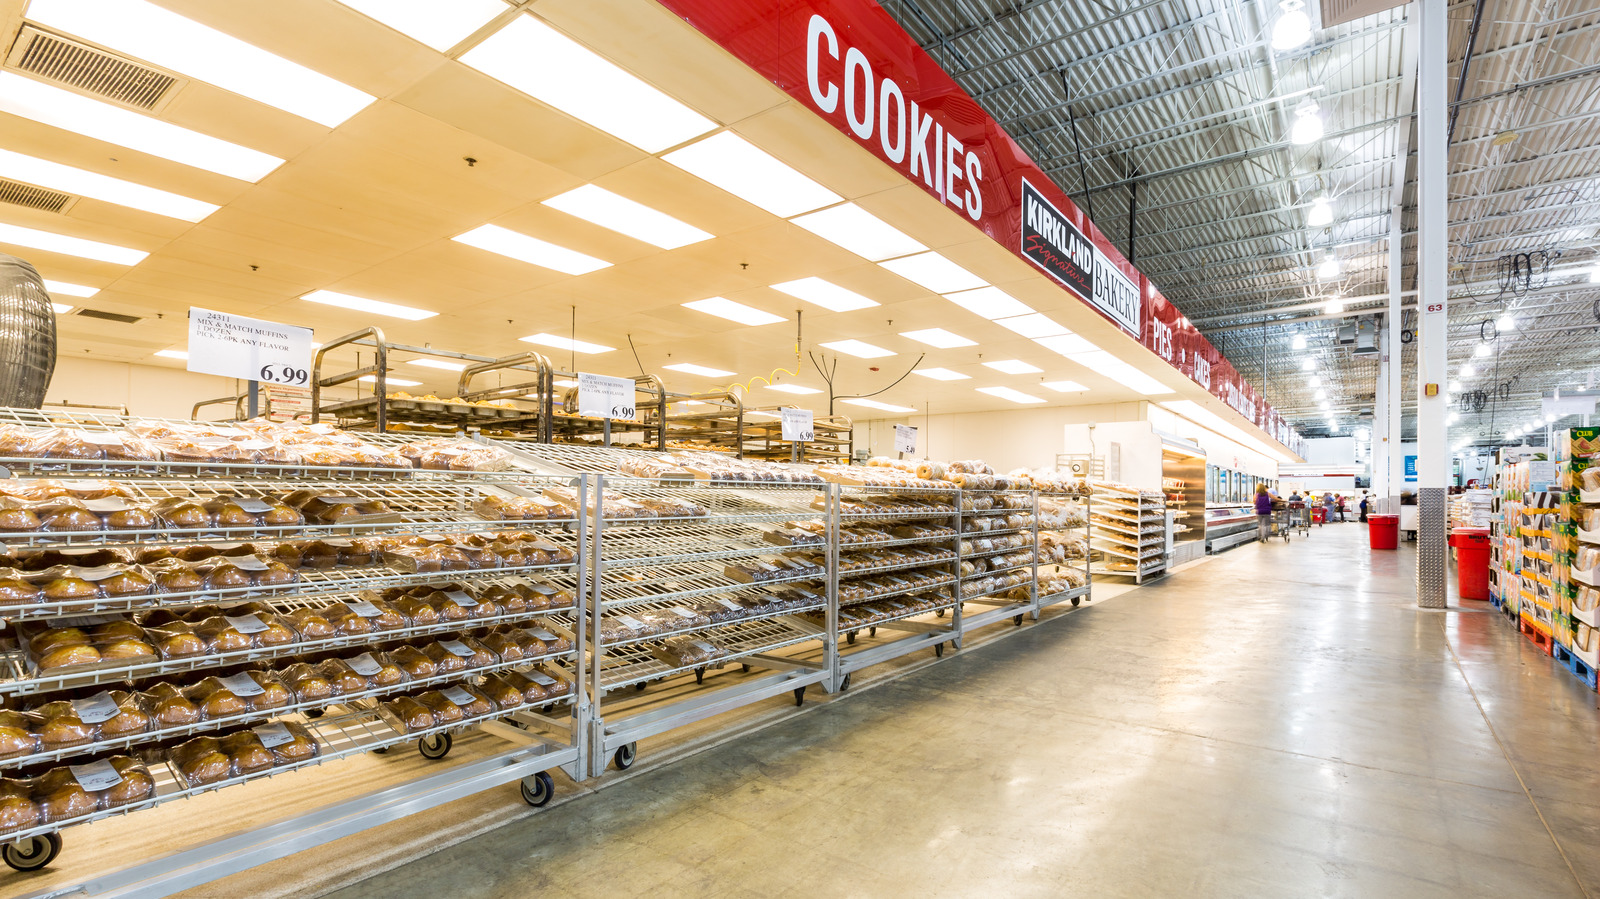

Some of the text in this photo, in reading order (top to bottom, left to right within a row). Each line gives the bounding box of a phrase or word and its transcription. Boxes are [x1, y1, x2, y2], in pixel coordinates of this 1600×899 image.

[806, 14, 983, 221] COOKIES
[1027, 194, 1093, 275] KIRKLAND
[1026, 234, 1092, 291] Signature
[1095, 258, 1138, 326] BAKERY
[207, 312, 230, 322] 24311
[1427, 303, 1443, 312] 63
[197, 318, 213, 326] MIX
[224, 323, 253, 334] MATCH
[255, 328, 289, 340] MUFFINS
[203, 326, 232, 335] DOZEN
[1153, 316, 1173, 362] PIES
[196, 330, 215, 339] PICK
[240, 338, 257, 346] ANY
[259, 341, 289, 352] FLAVOR
[260, 364, 308, 385] 6.99
[611, 406, 635, 418] 6.99
[799, 431, 814, 440] 6.99
[1576, 430, 1594, 438] CLUB
